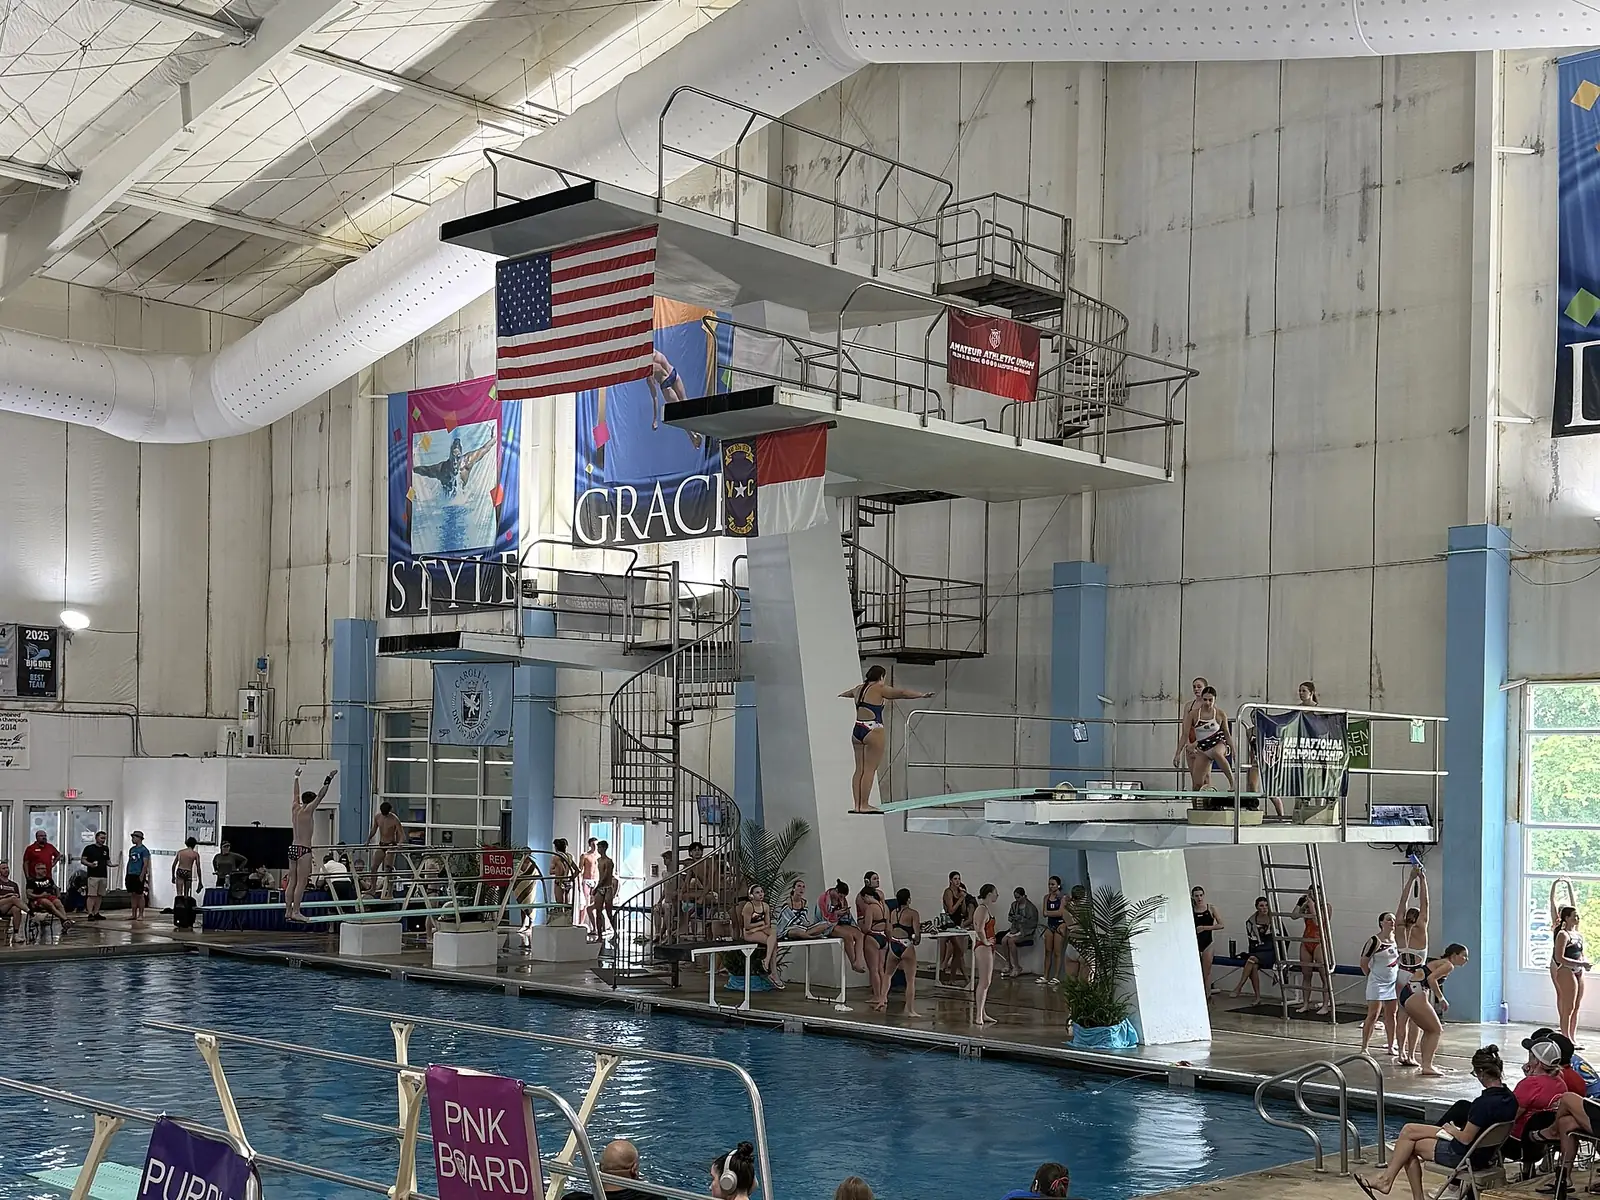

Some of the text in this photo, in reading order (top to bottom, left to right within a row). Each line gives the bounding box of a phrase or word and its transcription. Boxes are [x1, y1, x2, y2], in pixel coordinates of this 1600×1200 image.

[949, 342, 982, 357] AMATEUR
[983, 350, 1016, 365] ATHLETIC
[1015, 358, 1035, 370] UNION
[390, 550, 518, 612] STYLE
[25, 629, 50, 641] 2025
[38, 660, 52, 669] DIVE
[29, 673, 45, 682] BEST
[28, 681, 46, 689] TEAM
[1, 723, 17, 731] 2014
[1299, 737, 1343, 750] NATIONAL
[1348, 743, 1368, 756] ARD
[1282, 747, 1344, 762] CHAMPIONSHIP
[489, 854, 507, 865] RED
[484, 865, 513, 876] BOARD
[438, 1141, 529, 1195] BOARD
